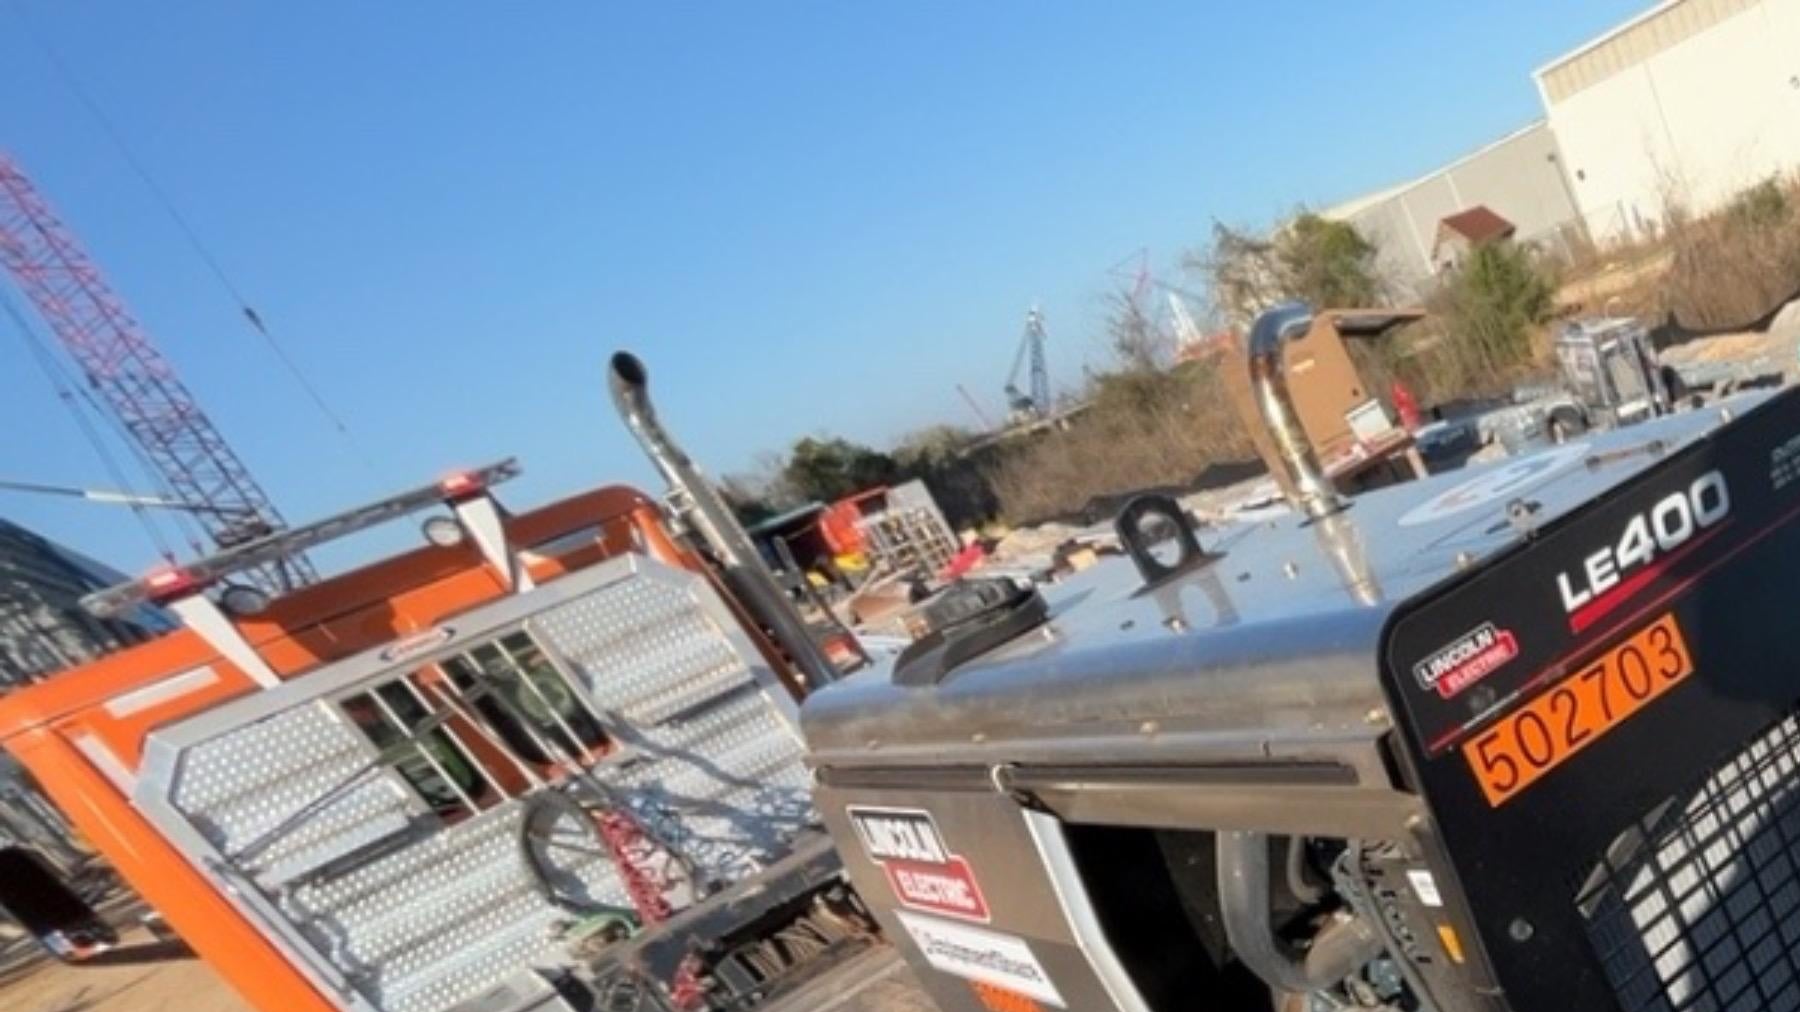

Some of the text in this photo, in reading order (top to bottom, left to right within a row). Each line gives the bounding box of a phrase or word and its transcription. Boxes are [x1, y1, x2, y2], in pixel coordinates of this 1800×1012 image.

[1556, 468, 1731, 615] LE400
[1420, 627, 1496, 684] LINCOLN
[1476, 624, 1685, 794] 502703
